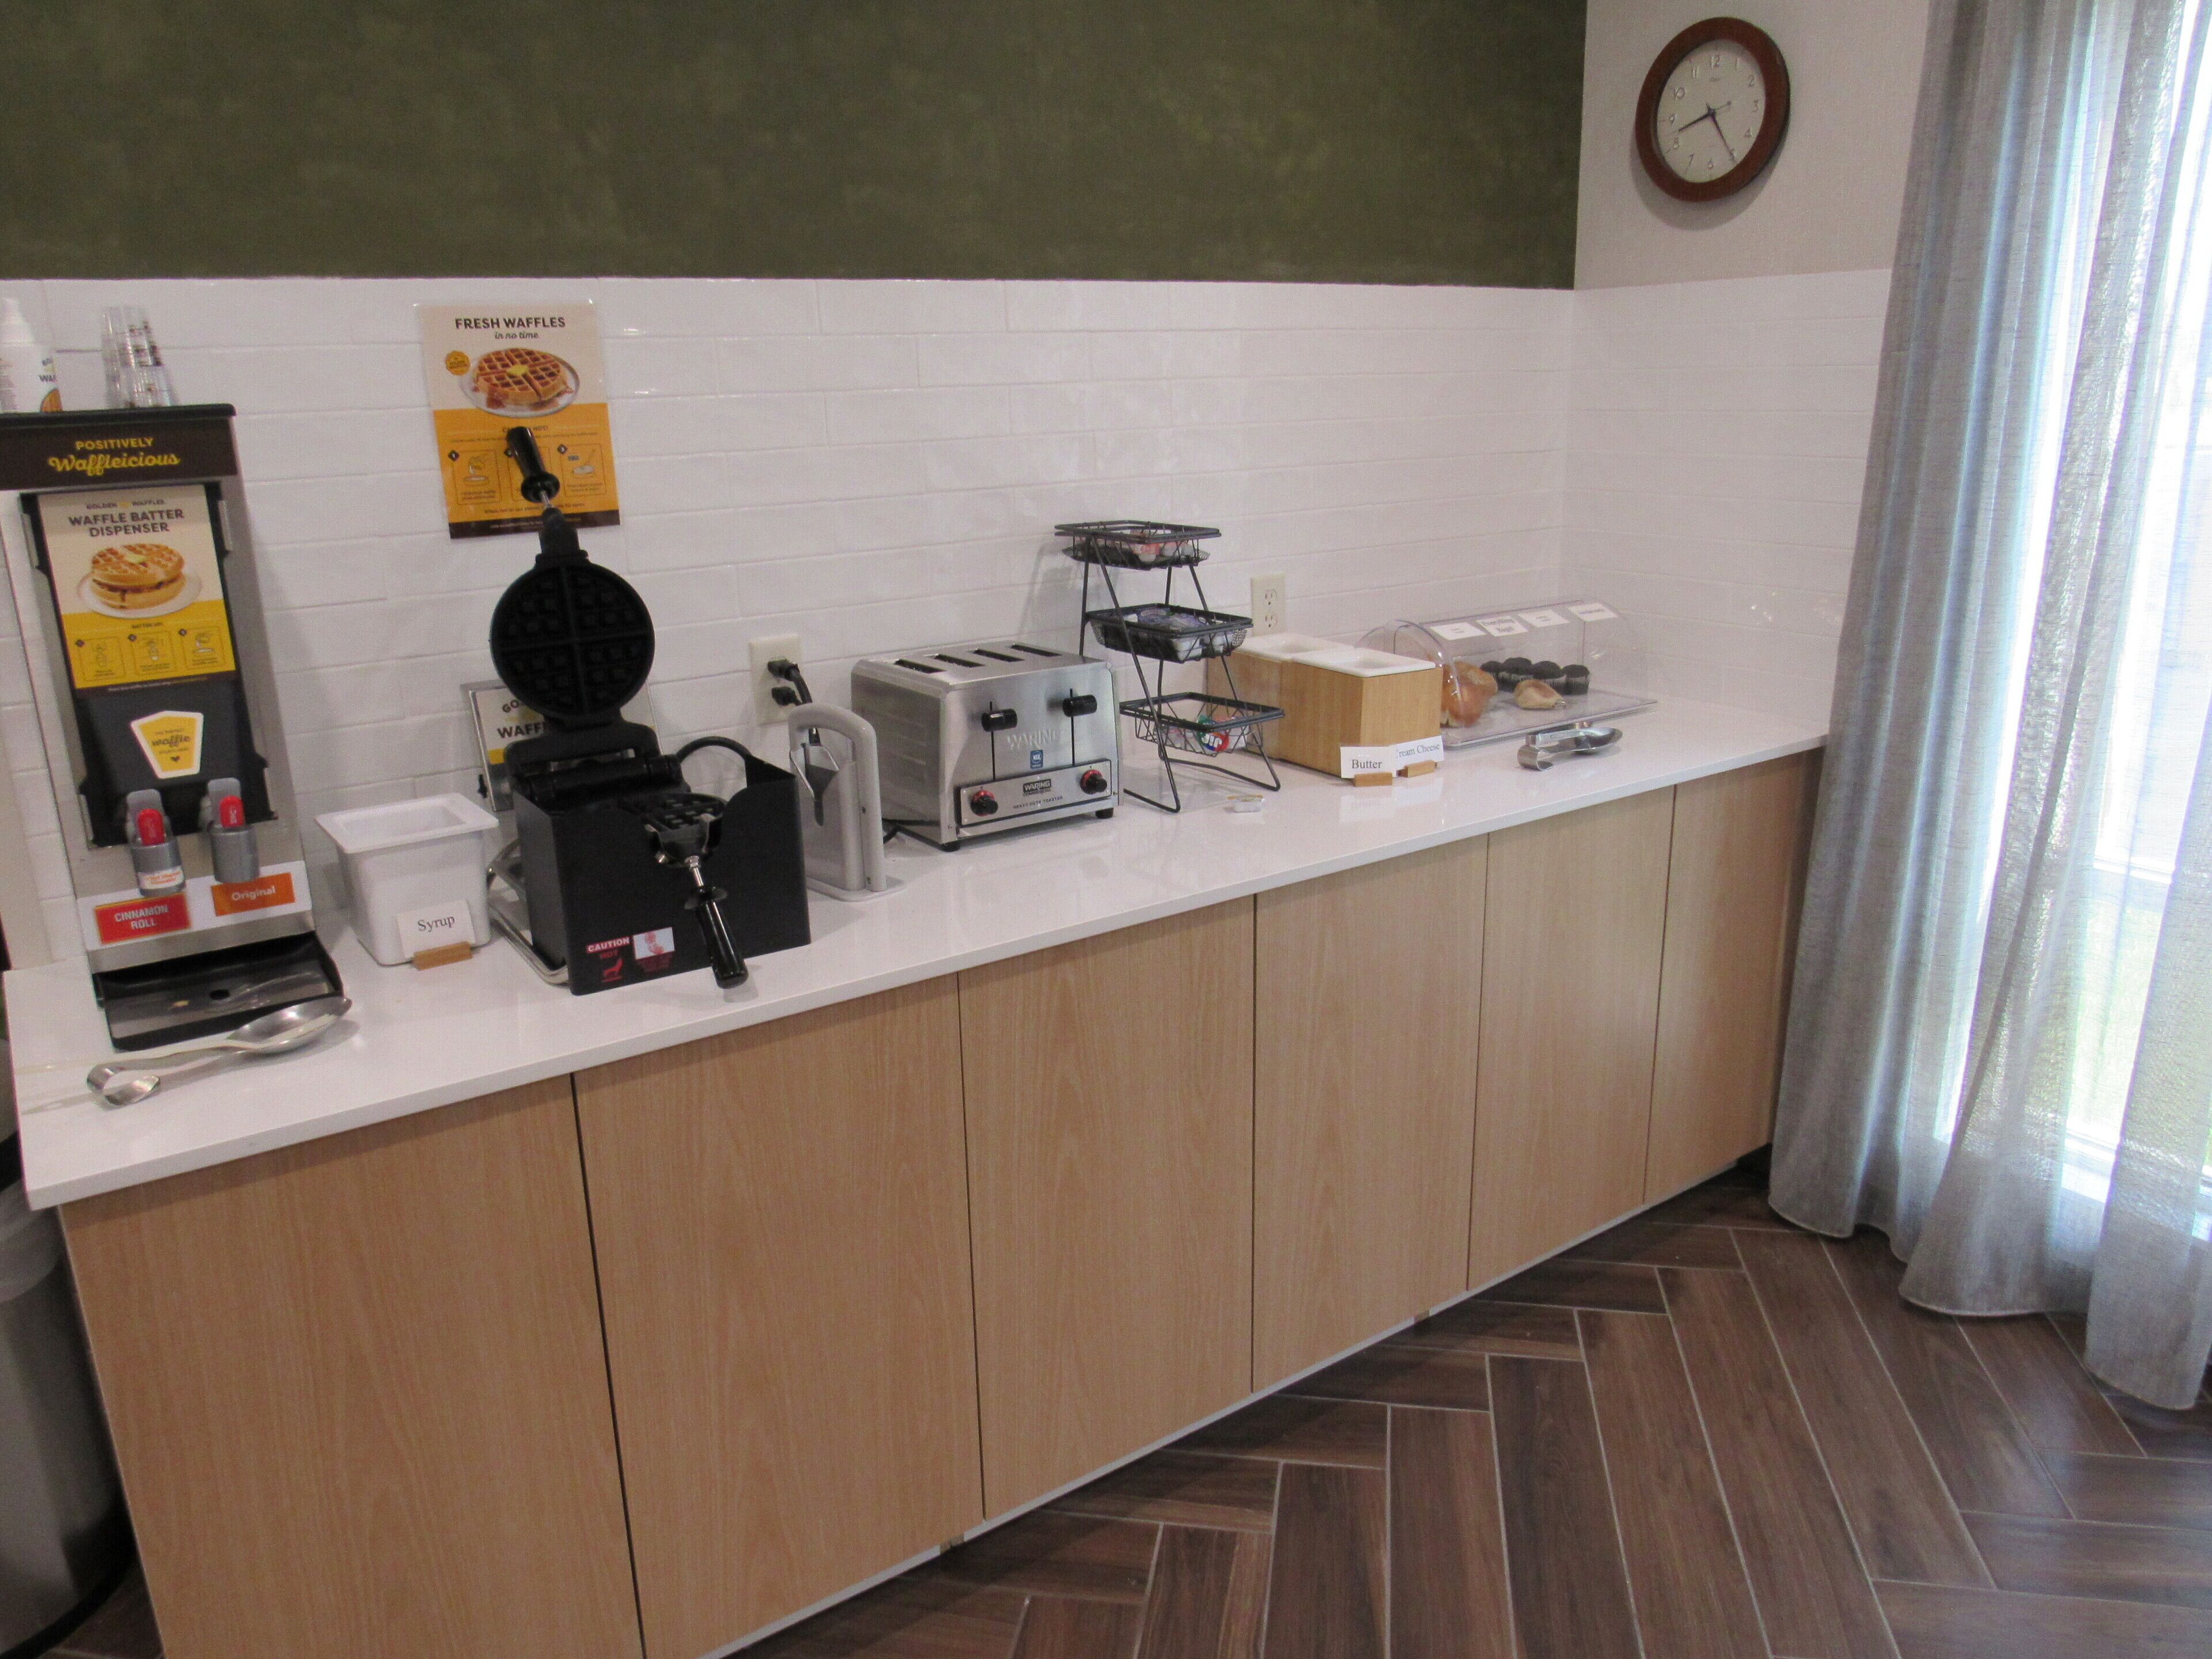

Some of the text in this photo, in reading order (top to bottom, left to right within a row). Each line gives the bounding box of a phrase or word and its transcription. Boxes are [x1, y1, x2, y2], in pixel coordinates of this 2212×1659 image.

[1710, 54, 1721, 69] 12
[1691, 66, 1700, 78] 11
[1748, 74, 1755, 86] 2
[1674, 87, 1687, 100] 10
[1752, 100, 1759, 112] 3
[1669, 113, 1677, 125] 9
[1744, 128, 1753, 138] 4
[1673, 138, 1679, 149] 8
[1688, 153, 1695, 166] 7
[1707, 157, 1714, 170] 6
[455, 317, 566, 329] FRESH WAFFLES
[519, 331, 539, 339] time
[75, 438, 154, 450] POSITIVELY
[49, 452, 181, 476] Waffleicious
[69, 509, 184, 527] WAFFLE BATTER
[89, 522, 170, 537] DISPENSER
[1396, 743, 1440, 758] ream Cheese
[1352, 759, 1382, 769] Butter
[1024, 779, 1051, 791] WARING
[231, 885, 276, 900] Original
[115, 904, 169, 922] CINNAMON
[130, 919, 157, 930] ROLL
[418, 916, 455, 933] Syrup
[588, 937, 630, 952] CAUTION
